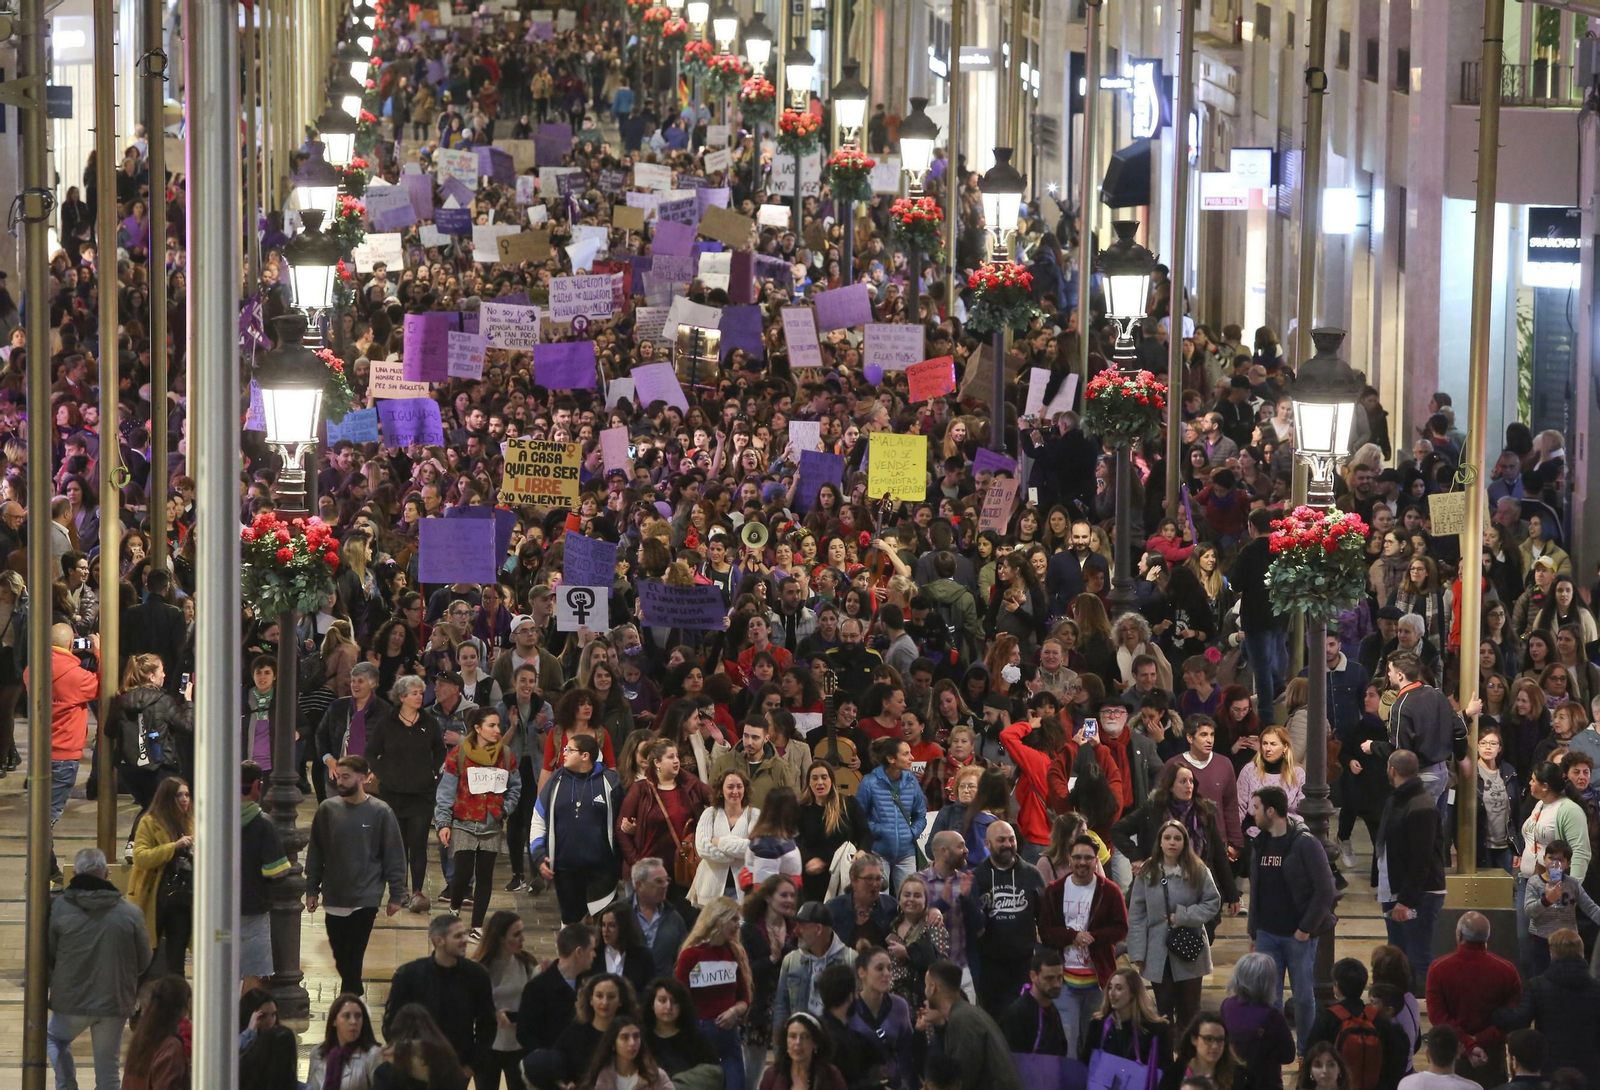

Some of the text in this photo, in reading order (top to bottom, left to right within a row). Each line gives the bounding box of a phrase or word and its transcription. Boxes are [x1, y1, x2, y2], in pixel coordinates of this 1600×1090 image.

[509, 439, 526, 449] DE
[518, 451, 563, 464] A CASA
[883, 450, 912, 459] NO SE
[505, 463, 579, 480] QUIERO SER
[513, 478, 563, 495] LIBRE
[871, 477, 918, 485] FEMINISTAS
[518, 494, 572, 506] VALIENTE
[648, 583, 709, 595] EL FEMINISMO
[646, 592, 656, 600] ES
[659, 595, 674, 603] UNA
[472, 772, 506, 783] JUNTAS
[692, 968, 735, 985] JUNTAS
